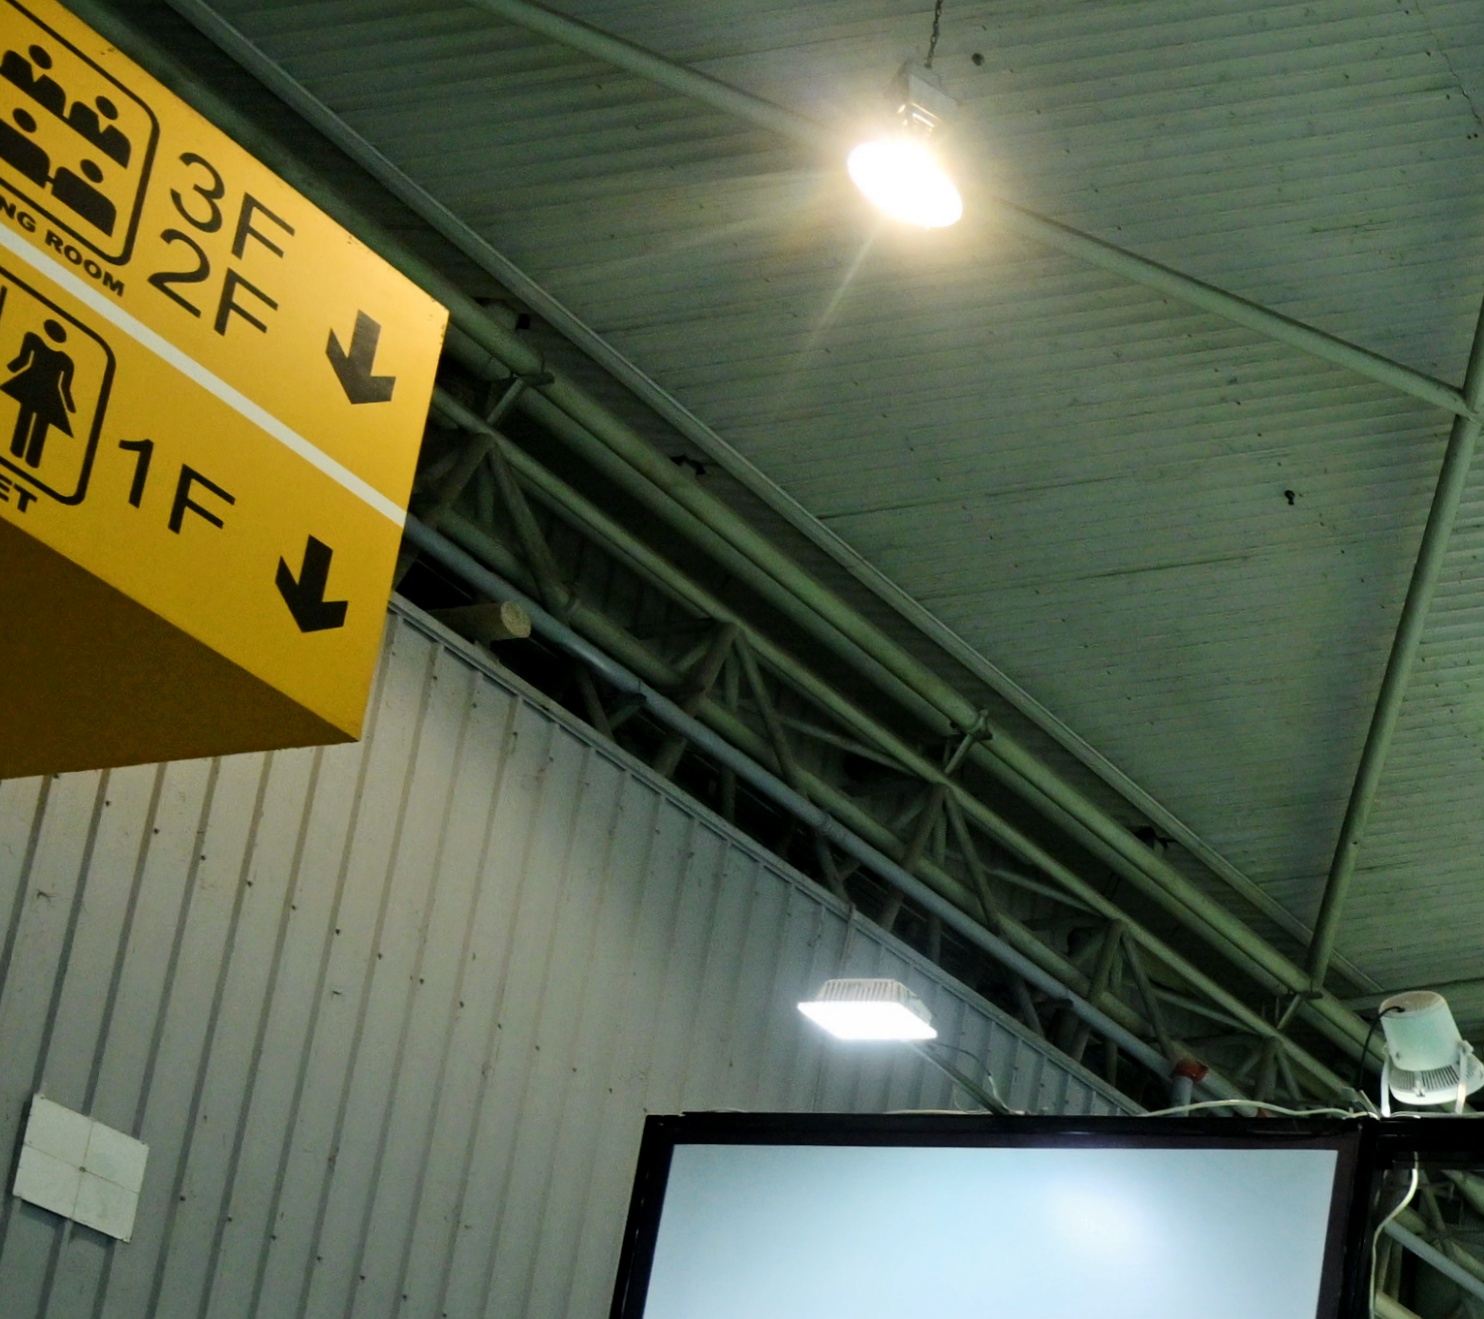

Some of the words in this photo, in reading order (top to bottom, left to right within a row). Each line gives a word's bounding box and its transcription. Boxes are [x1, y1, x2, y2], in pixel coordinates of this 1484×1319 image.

[170, 151, 296, 260] 3F
[45, 229, 125, 297] ROOM
[148, 228, 279, 337] 2F
[118, 437, 236, 535] 1F
